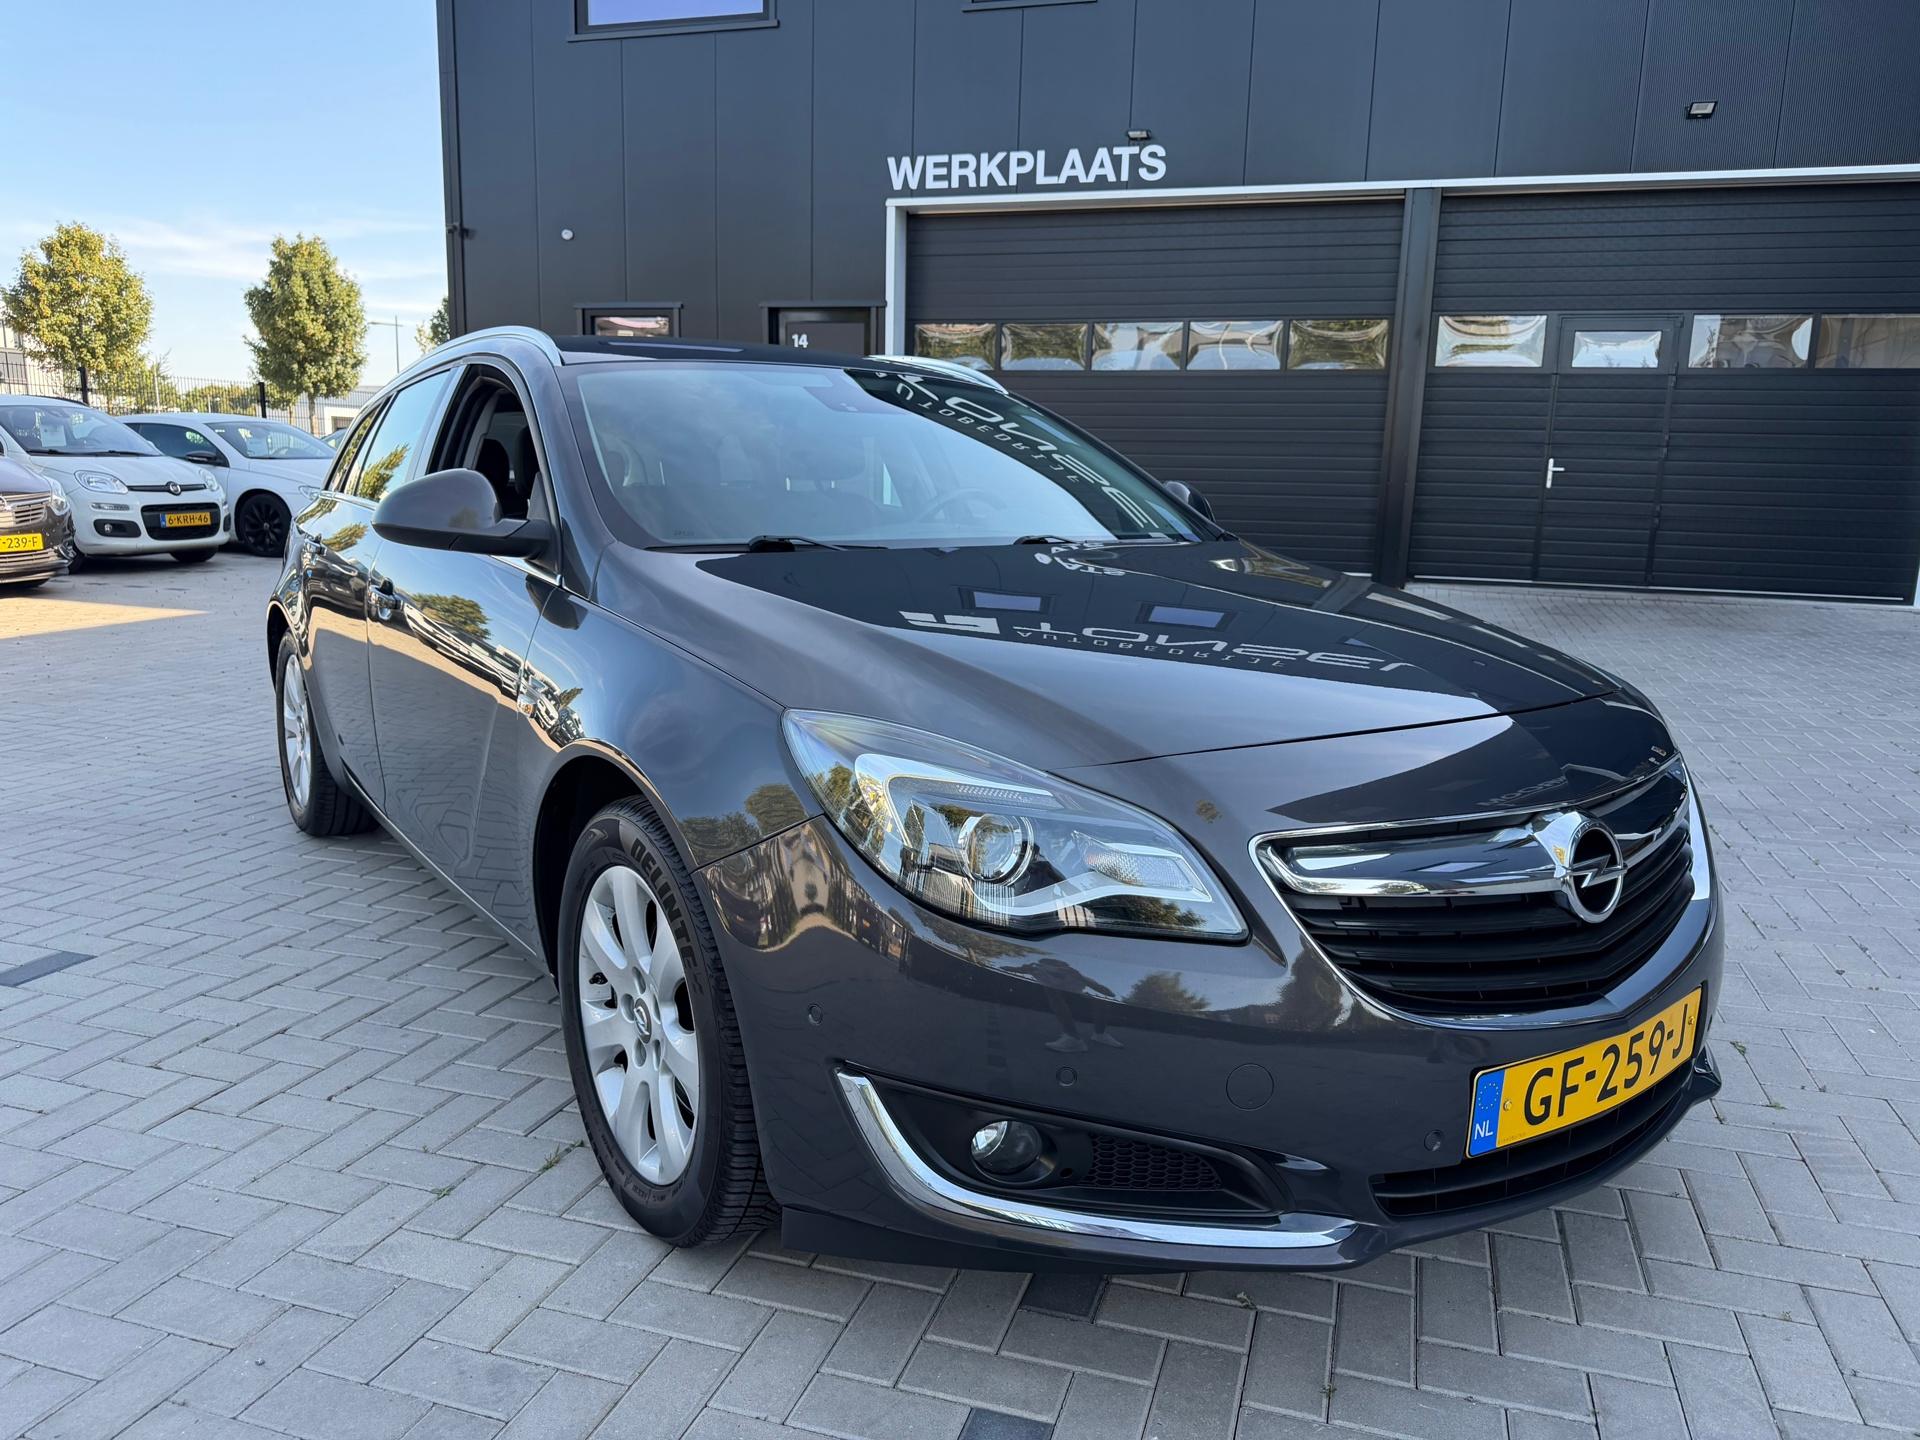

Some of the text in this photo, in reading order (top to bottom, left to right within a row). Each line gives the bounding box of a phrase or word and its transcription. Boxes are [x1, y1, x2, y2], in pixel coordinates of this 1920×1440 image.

[887, 144, 1167, 190] WERKPLAATS
[792, 333, 808, 348] 14
[168, 514, 209, 525] 6-KRH-46
[0, 536, 39, 549] -239-F
[1523, 1003, 1688, 1126] GF-259-J
[1474, 1121, 1493, 1140] NL
